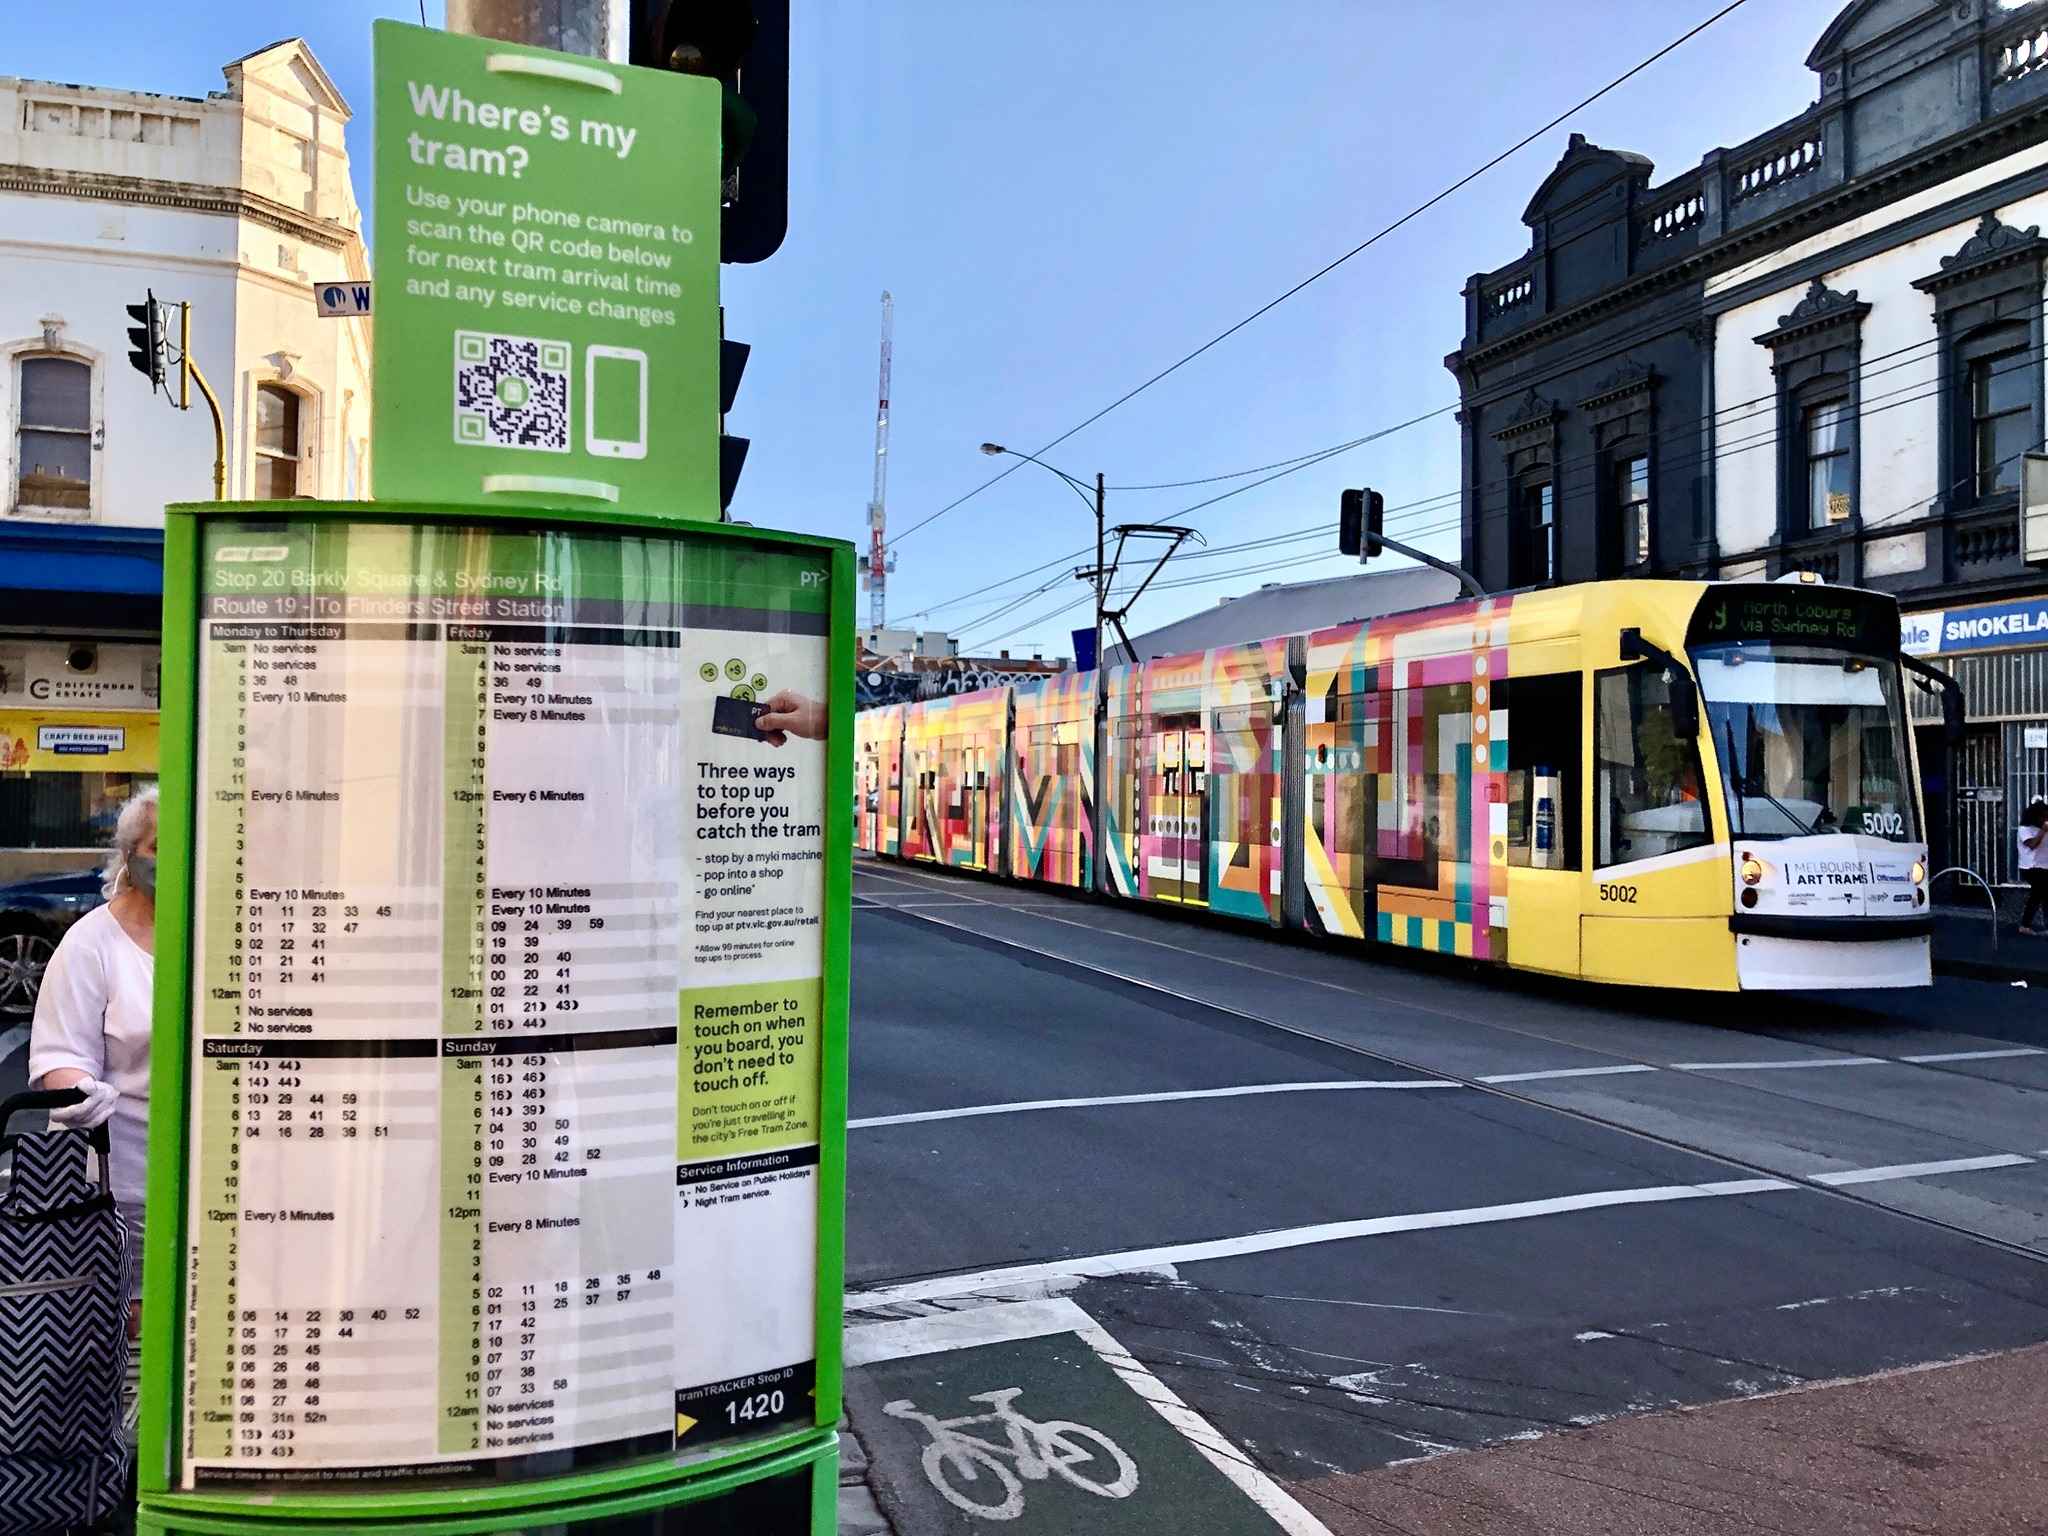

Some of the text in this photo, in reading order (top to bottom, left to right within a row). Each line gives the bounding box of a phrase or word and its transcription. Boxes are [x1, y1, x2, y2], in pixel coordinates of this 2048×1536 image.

[407, 80, 637, 159] Where's my
[407, 132, 529, 178] tram?
[406, 184, 693, 245] Use your phone camera to
[406, 218, 671, 269] scan the QR code below
[406, 244, 682, 298] for next tram arrival time
[406, 276, 676, 327] and any service changes
[215, 569, 562, 594] Stop 20 Barkly Square & Sydney Rd
[213, 597, 564, 618] Route 19 To Flinders Street Station
[213, 626, 341, 638] Monday to Thursday
[450, 627, 492, 640] Friday
[1740, 618, 1855, 637] via Sydney Rd
[253, 692, 347, 704] Every 10 Minutes
[698, 763, 795, 782] Three ways
[697, 784, 774, 802] to top up
[697, 803, 789, 821] before you
[697, 823, 820, 839] catch the tram
[1863, 812, 1903, 835] 5002
[705, 850, 822, 865] stop by a myki machine
[1795, 862, 1866, 873] MELBOURNE
[704, 869, 725, 882] pop
[728, 869, 748, 879] into
[759, 868, 784, 879] shop
[1798, 874, 1823, 884] ART
[1827, 874, 1868, 884] TRAMS
[704, 887, 717, 899] go
[1600, 884, 1637, 904] 5002
[236, 906, 391, 916] 7 01 11 23 33 45
[695, 906, 804, 920] Find your nearest place to
[696, 916, 819, 933] top up at ptv.vic.gov.au/retail
[694, 998, 798, 1019] Remember to
[695, 1015, 805, 1038] touch on when
[206, 1043, 263, 1055] Saturday
[446, 1041, 497, 1053] Sunday
[694, 1034, 804, 1060] you board, you
[693, 1052, 794, 1075] don't need to
[693, 1071, 768, 1093] touch off.
[721, 1101, 747, 1113] touch
[749, 1101, 760, 1109] on
[774, 1096, 788, 1106] off
[789, 1095, 796, 1104] if
[723, 1116, 741, 1129] just
[744, 1110, 785, 1125] travelling
[787, 1108, 795, 1117] in
[693, 1133, 709, 1143] the
[738, 1127, 758, 1137] Free
[762, 1123, 784, 1135] Tram
[786, 1120, 809, 1131] Zone.
[680, 1154, 789, 1178] Service Information
[695, 1169, 811, 1194] No Service on Public Holidays
[208, 1211, 334, 1222] 12pm Every 8 Minutes
[473, 1270, 661, 1299] 5 02 11 18 26 35 48
[679, 1368, 793, 1401] tramTRACKER Stop ID
[725, 1390, 784, 1424] 1420
